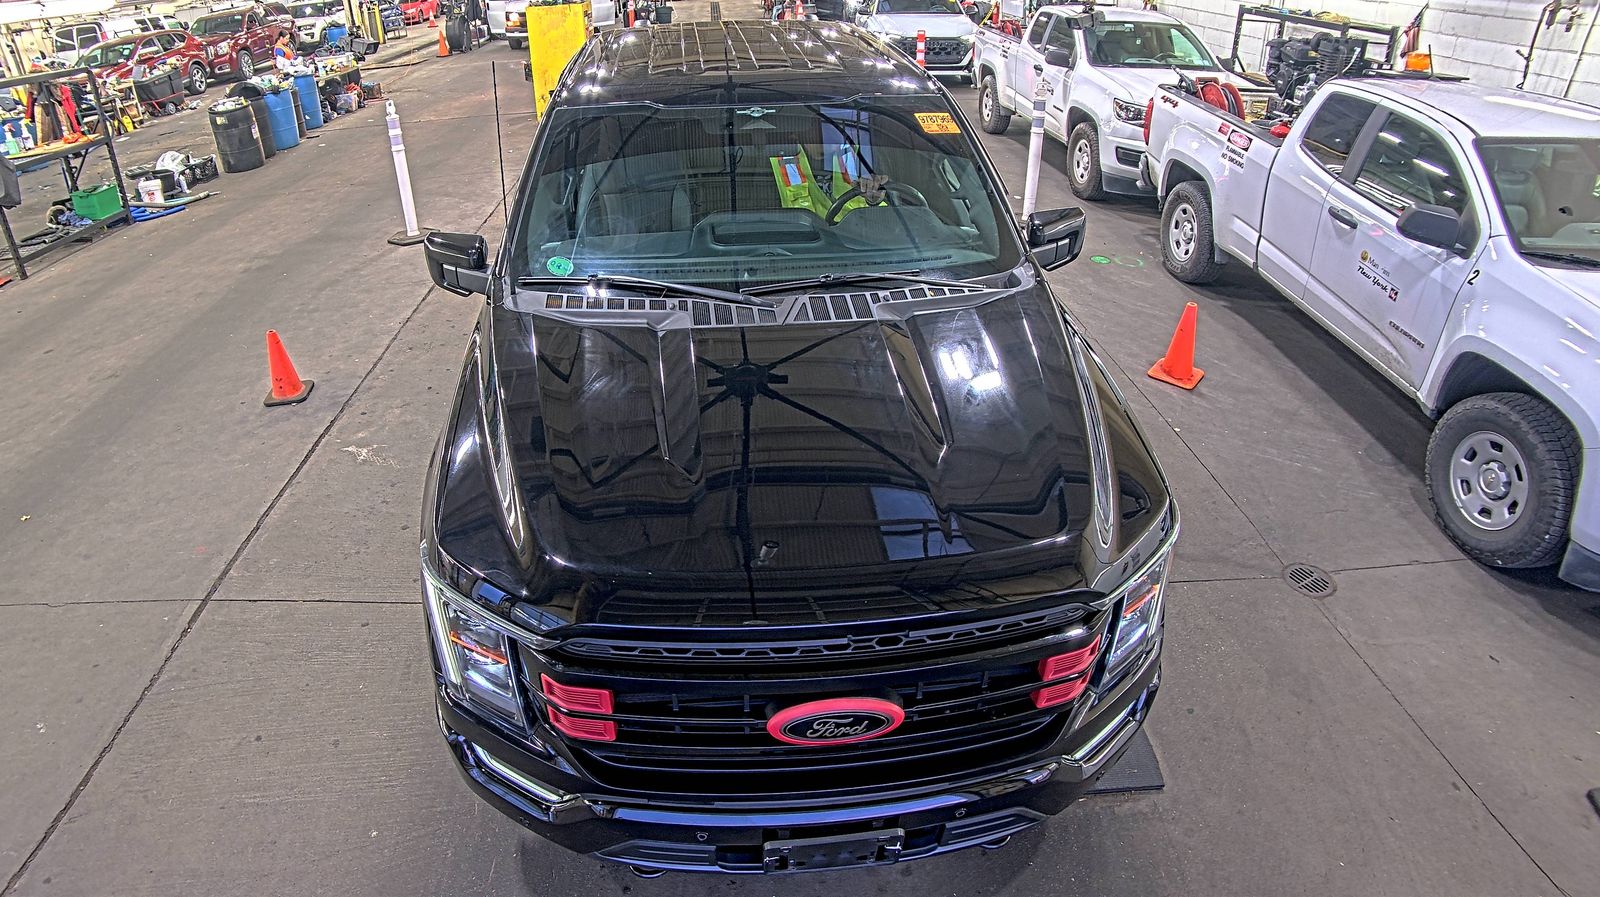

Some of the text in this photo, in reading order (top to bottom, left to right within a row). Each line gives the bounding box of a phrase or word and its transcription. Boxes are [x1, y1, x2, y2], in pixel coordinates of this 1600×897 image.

[1221, 152, 1244, 169] NO SMOKING
[1357, 265, 1389, 293] New York
[1467, 269, 1480, 286] 2
[806, 717, 869, 738] Ford
